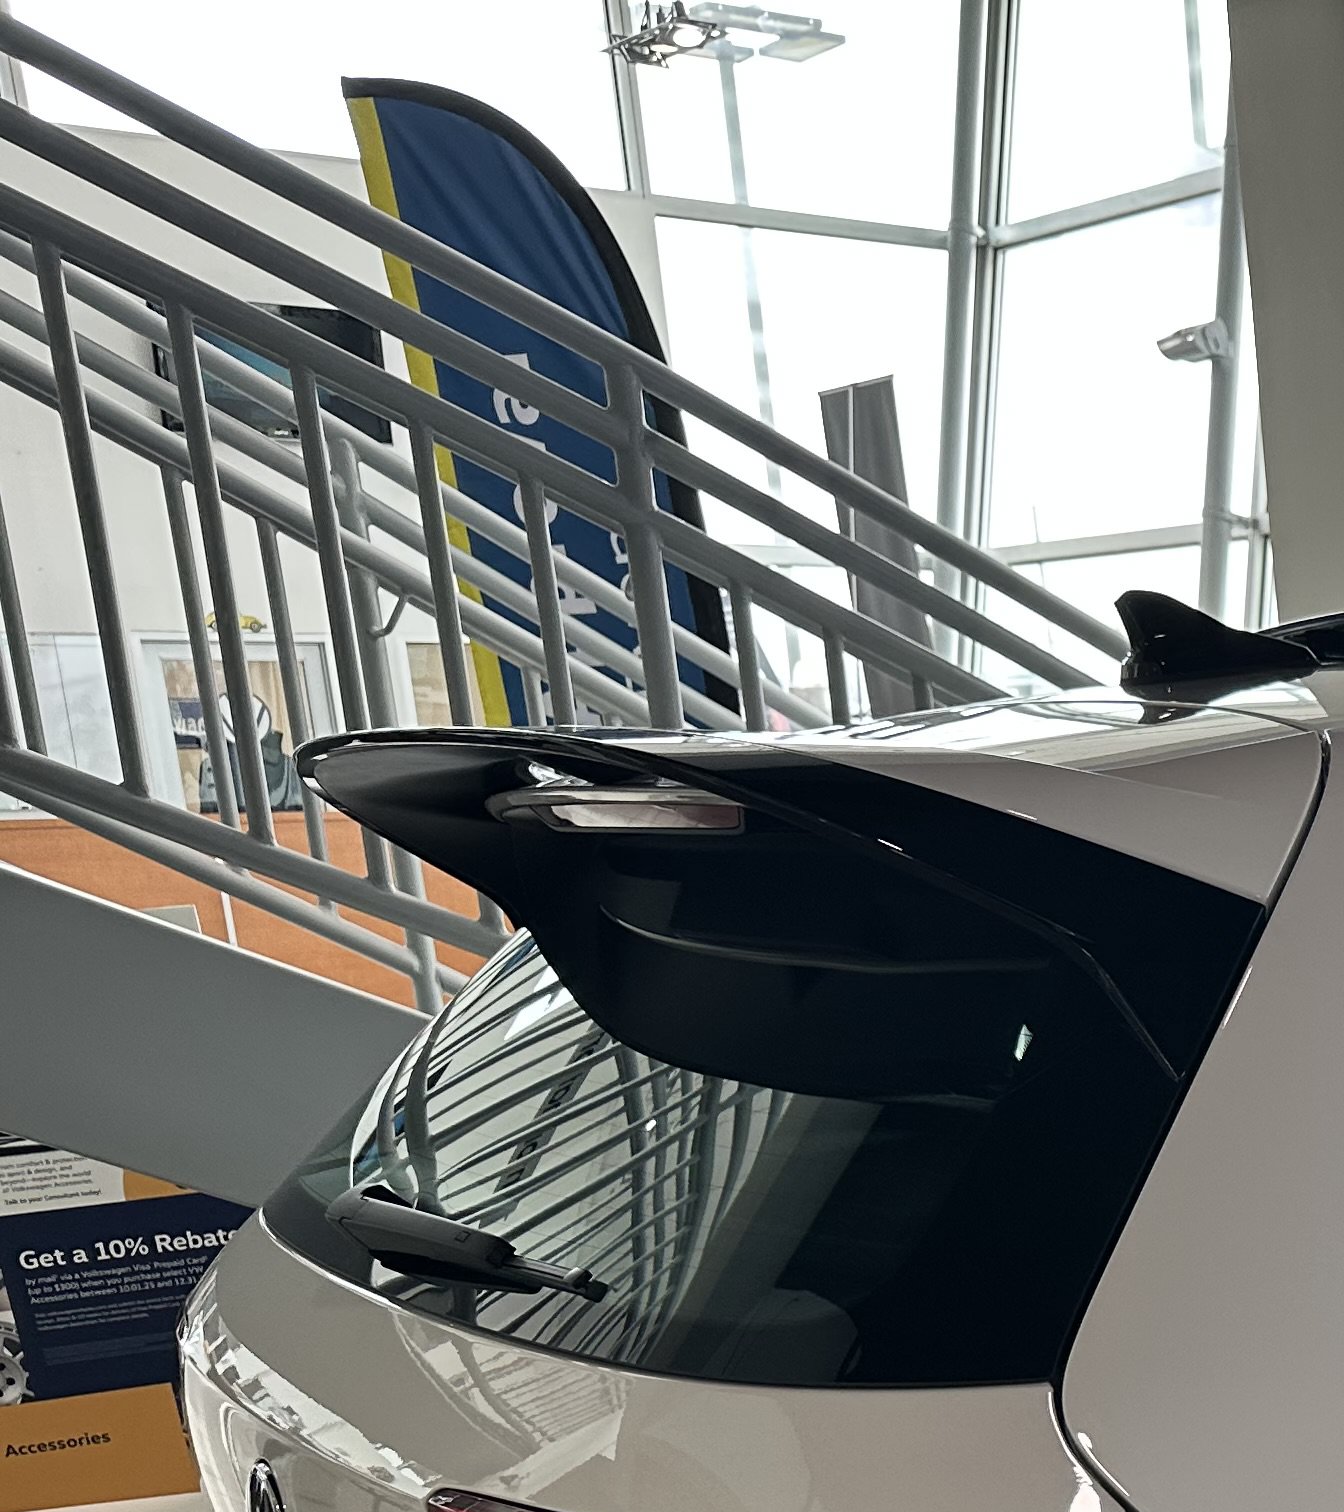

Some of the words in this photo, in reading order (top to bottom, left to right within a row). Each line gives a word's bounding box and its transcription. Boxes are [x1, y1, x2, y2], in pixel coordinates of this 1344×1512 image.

[19, 1248, 66, 1269] Get
[73, 1247, 89, 1264] a
[95, 1236, 149, 1261] 10%
[4, 1431, 112, 1458] Accessories
